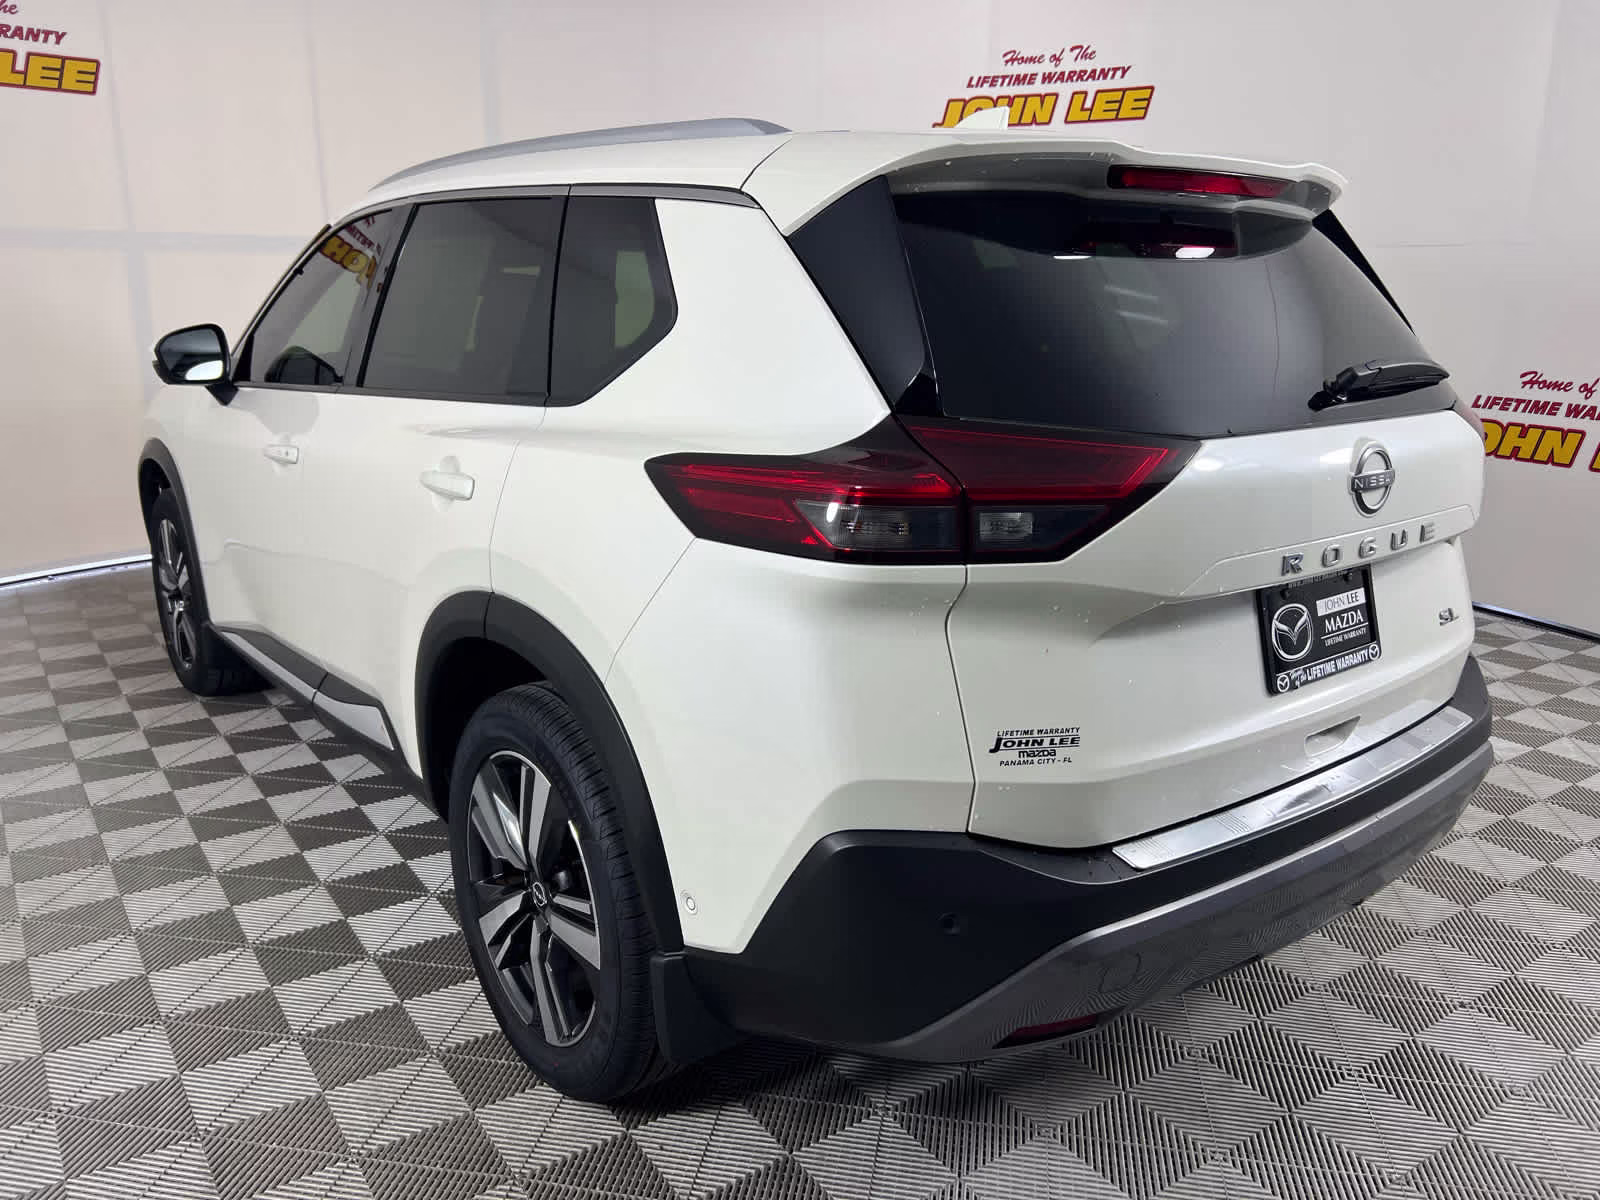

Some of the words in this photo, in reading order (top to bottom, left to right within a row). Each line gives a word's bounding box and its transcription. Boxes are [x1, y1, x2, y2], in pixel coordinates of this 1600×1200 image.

[1002, 49, 1045, 66] Home
[1050, 48, 1065, 68] of
[1070, 45, 1096, 62] The
[0, 48, 100, 95] LEE
[966, 72, 1038, 89] LIFETIME
[1041, 65, 1132, 85] WARRANTY
[1064, 85, 1155, 124] LEE
[1519, 370, 1573, 392] Home
[1578, 377, 1600, 400] of
[1471, 394, 1562, 416] LIFETIME
[1281, 522, 1436, 576] ROGUE
[1325, 596, 1345, 611] JOHN
[1346, 591, 1360, 604] LEE
[1325, 609, 1364, 633] MAZDA
[1439, 607, 1460, 626] SL
[1306, 660, 1336, 681] LIFETIME
[1336, 648, 1369, 671] WARRANTY
[997, 729, 1035, 737] LIFETIME
[1037, 727, 1080, 735] WARRANTY
[989, 737, 1045, 753] JOHN
[1049, 736, 1080, 746] LEE
[999, 759, 1035, 767] PANAMA
[1037, 757, 1056, 765] CITY
